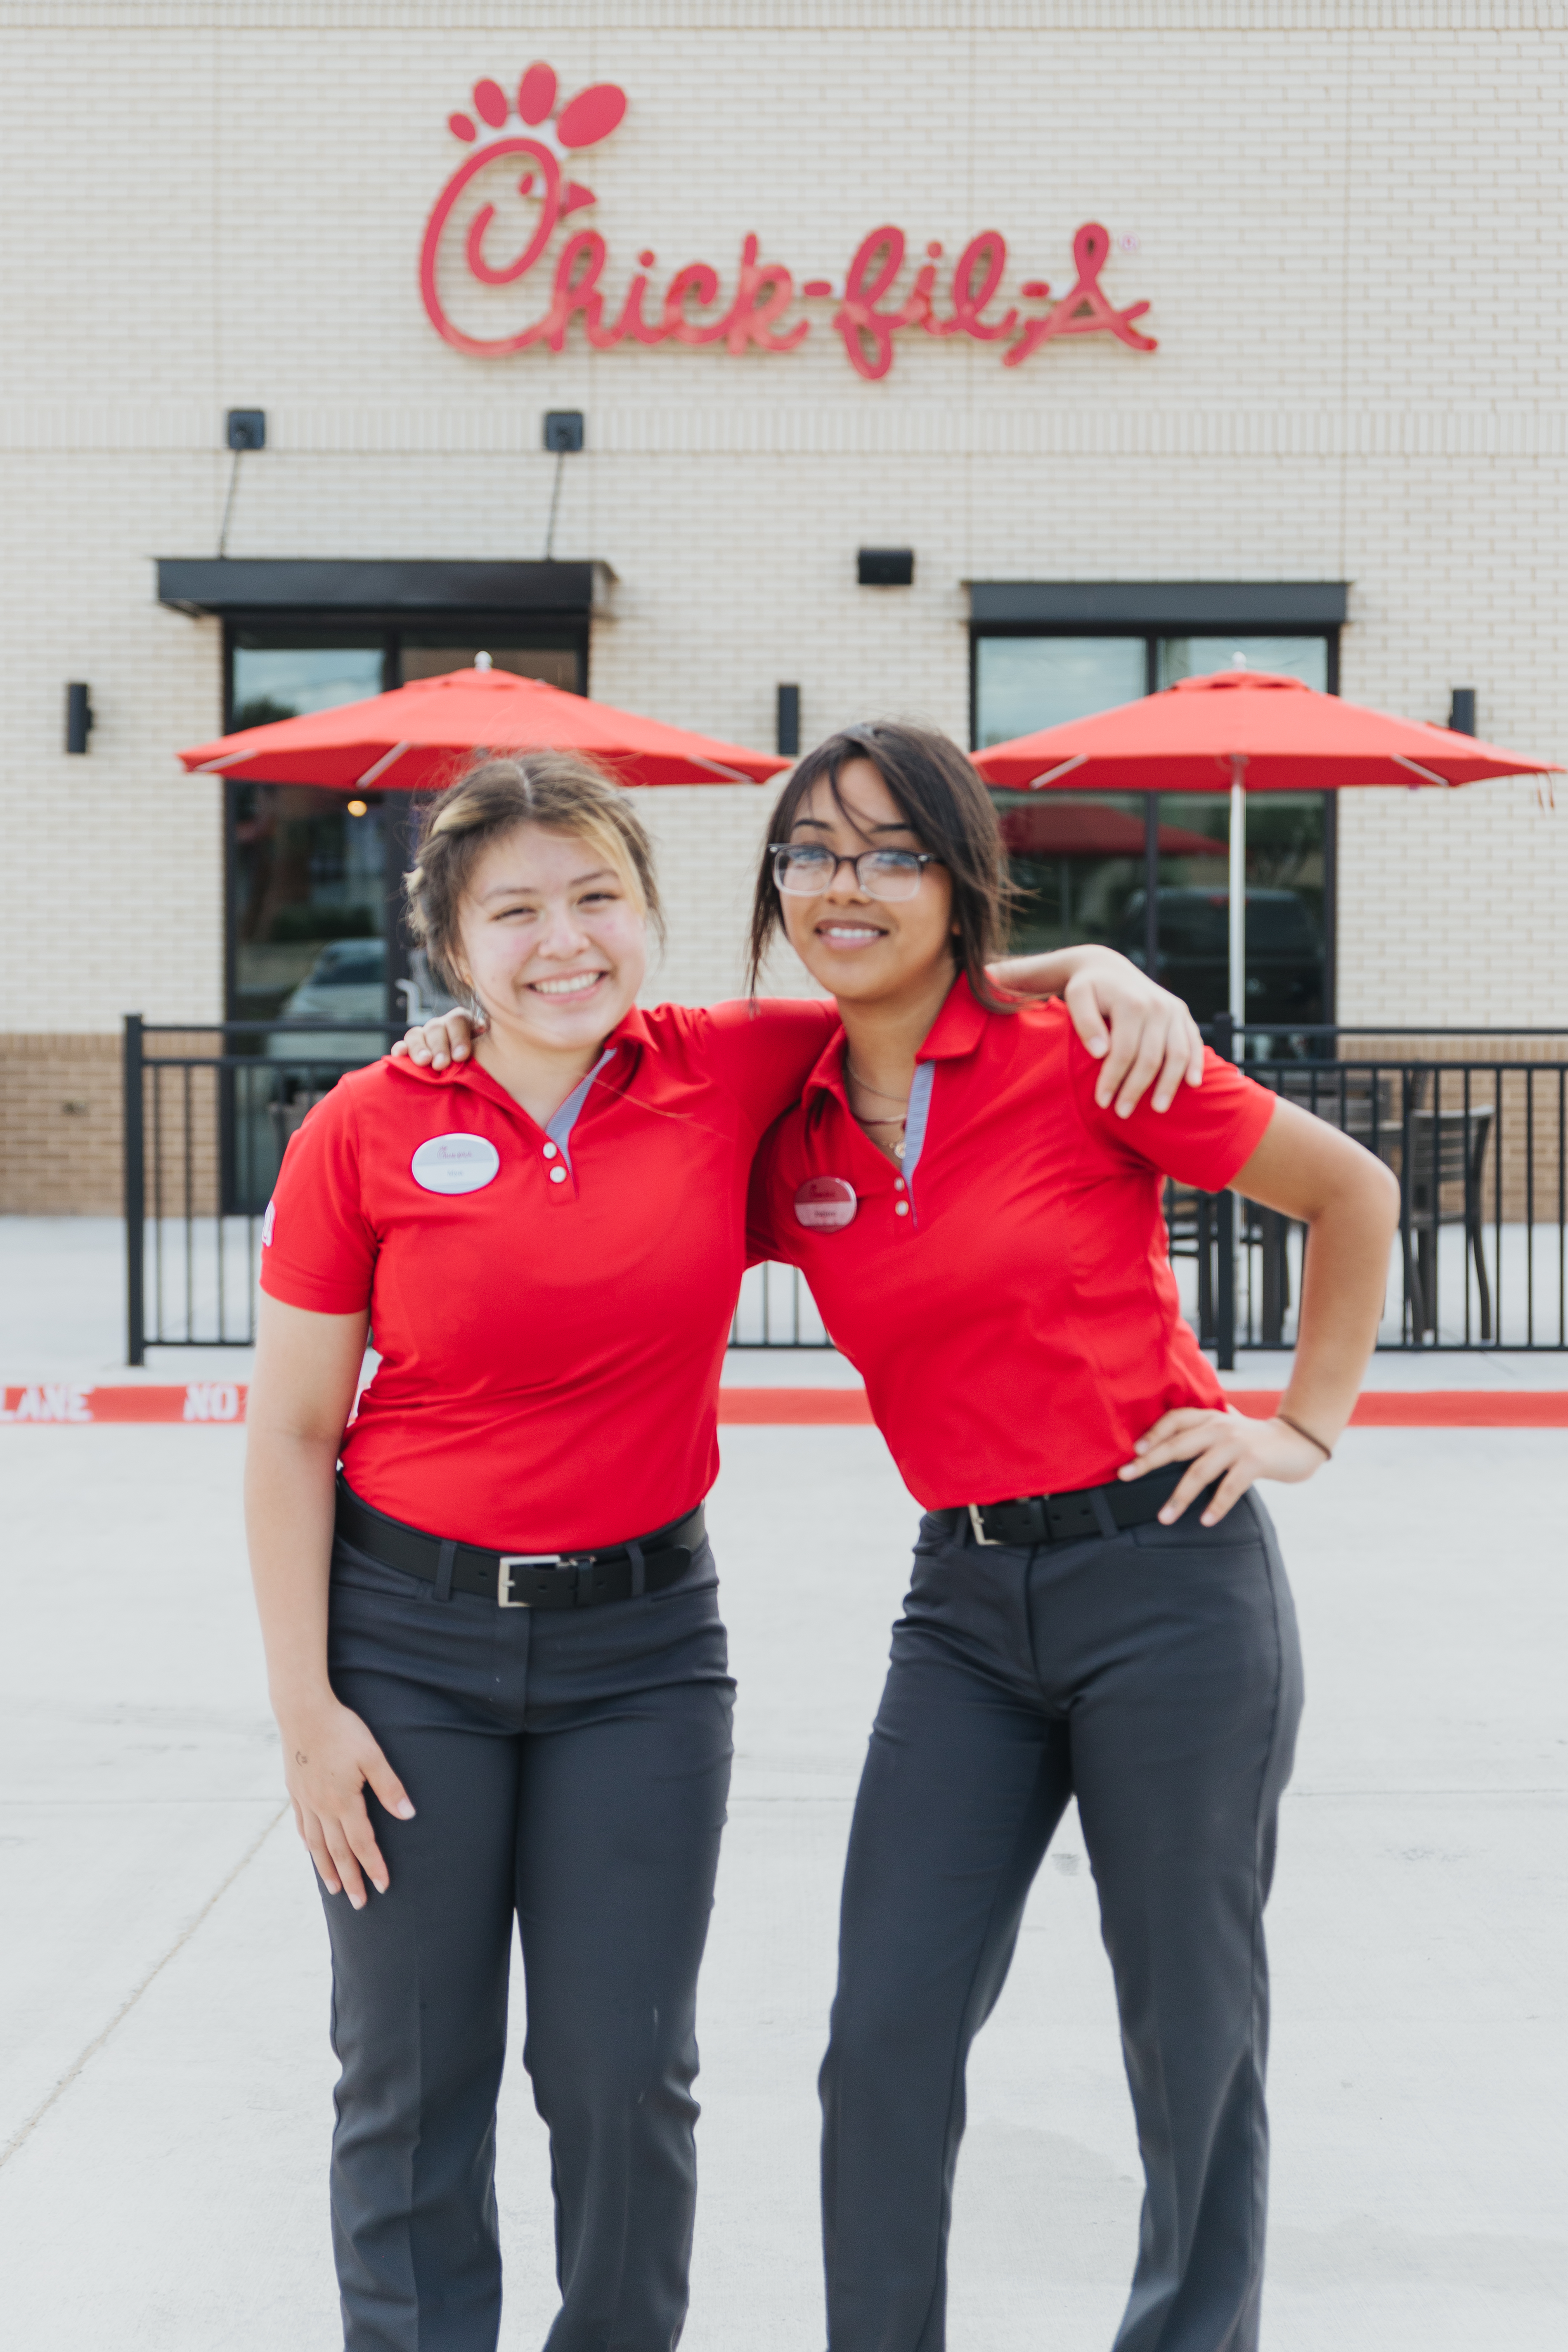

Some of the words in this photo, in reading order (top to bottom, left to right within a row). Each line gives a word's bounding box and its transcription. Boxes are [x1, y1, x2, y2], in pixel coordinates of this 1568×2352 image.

[419, 134, 1158, 381] Chick-fil-A
[0, 1382, 95, 1421] LANE
[182, 1382, 238, 1421] NO
